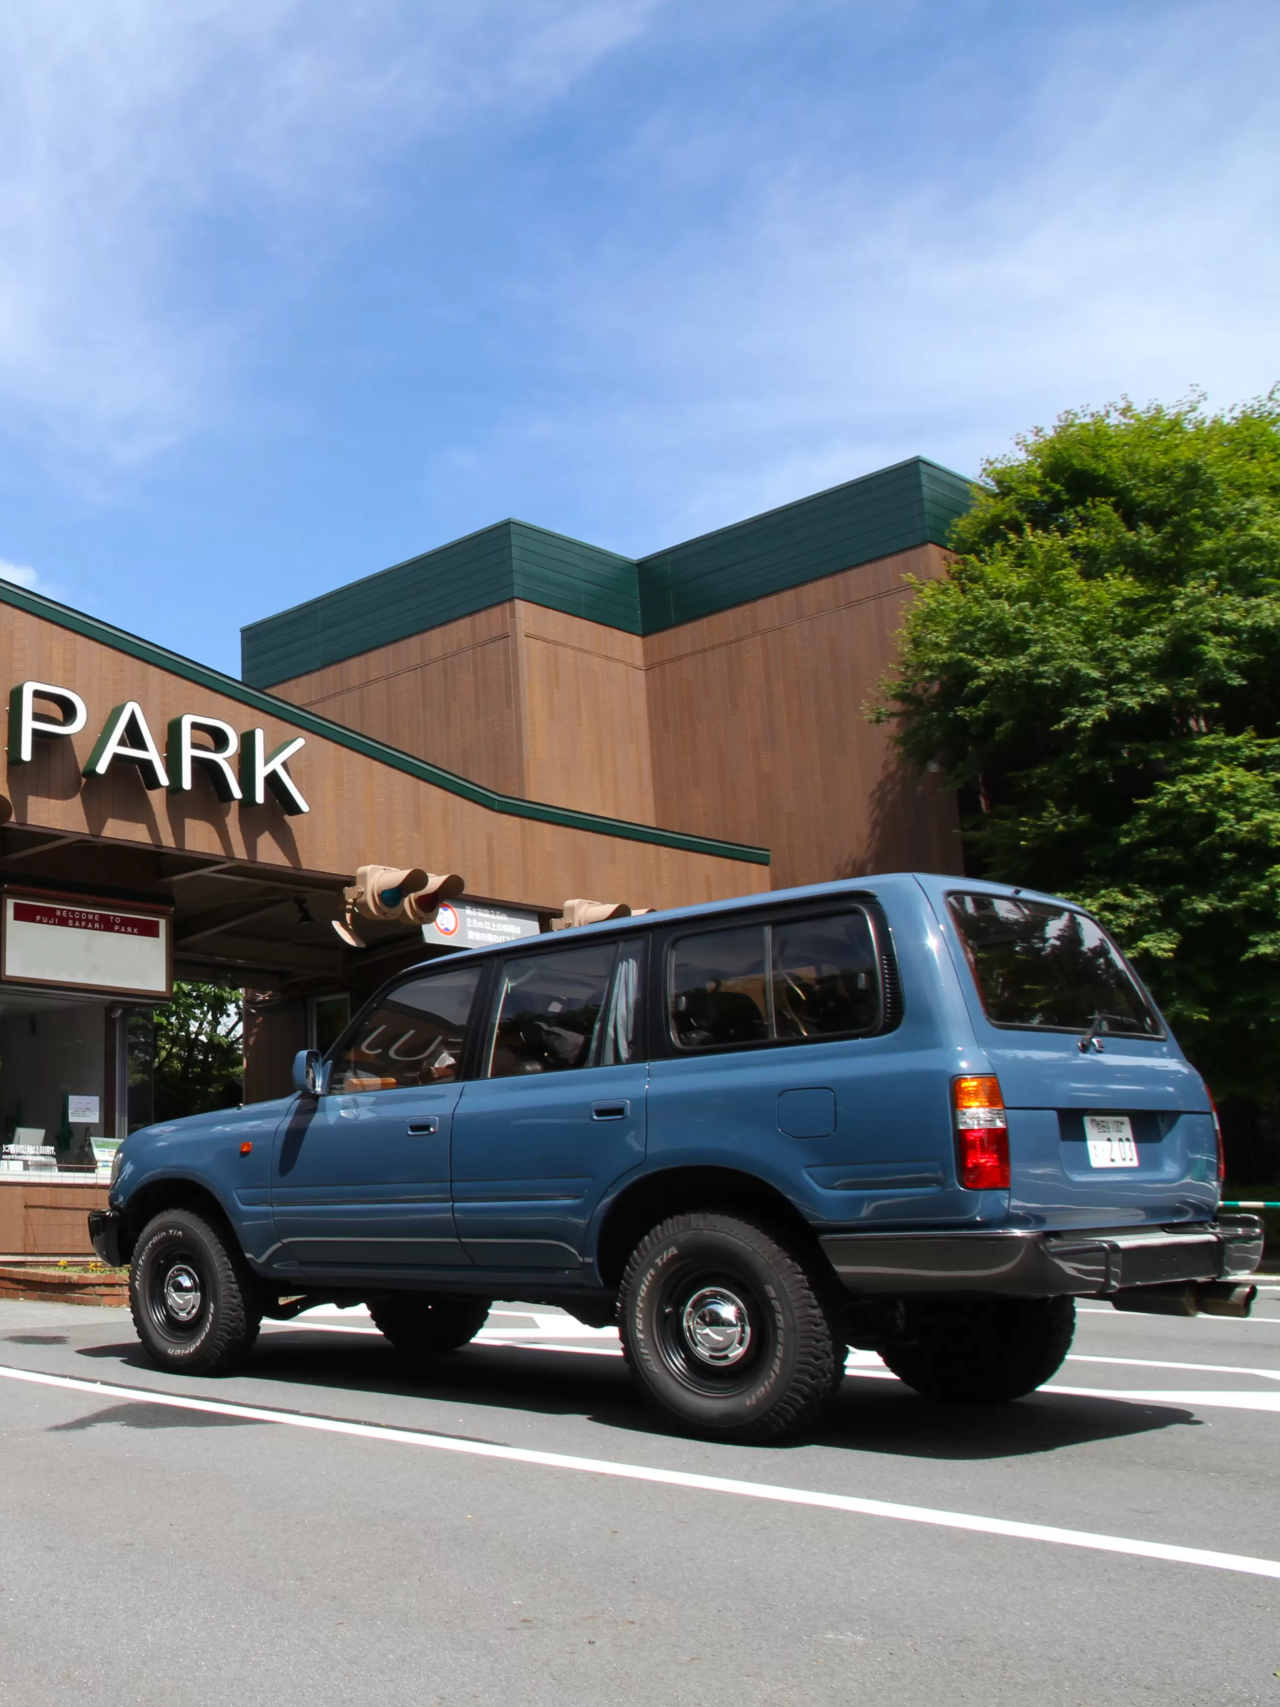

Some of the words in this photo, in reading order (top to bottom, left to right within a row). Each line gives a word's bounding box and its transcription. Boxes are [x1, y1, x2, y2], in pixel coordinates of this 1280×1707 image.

[14, 680, 310, 815] PARK
[36, 915, 59, 925] FUJI
[68, 919, 104, 930] SAFARI
[114, 926, 139, 934] PARK
[55, 909, 100, 921] WELCOME
[110, 916, 121, 924] TO
[134, 1232, 166, 1291] All-Terrain
[168, 1229, 184, 1238] T/A
[634, 1268, 659, 1375] All-Terrain
[654, 1246, 679, 1268] T/A
